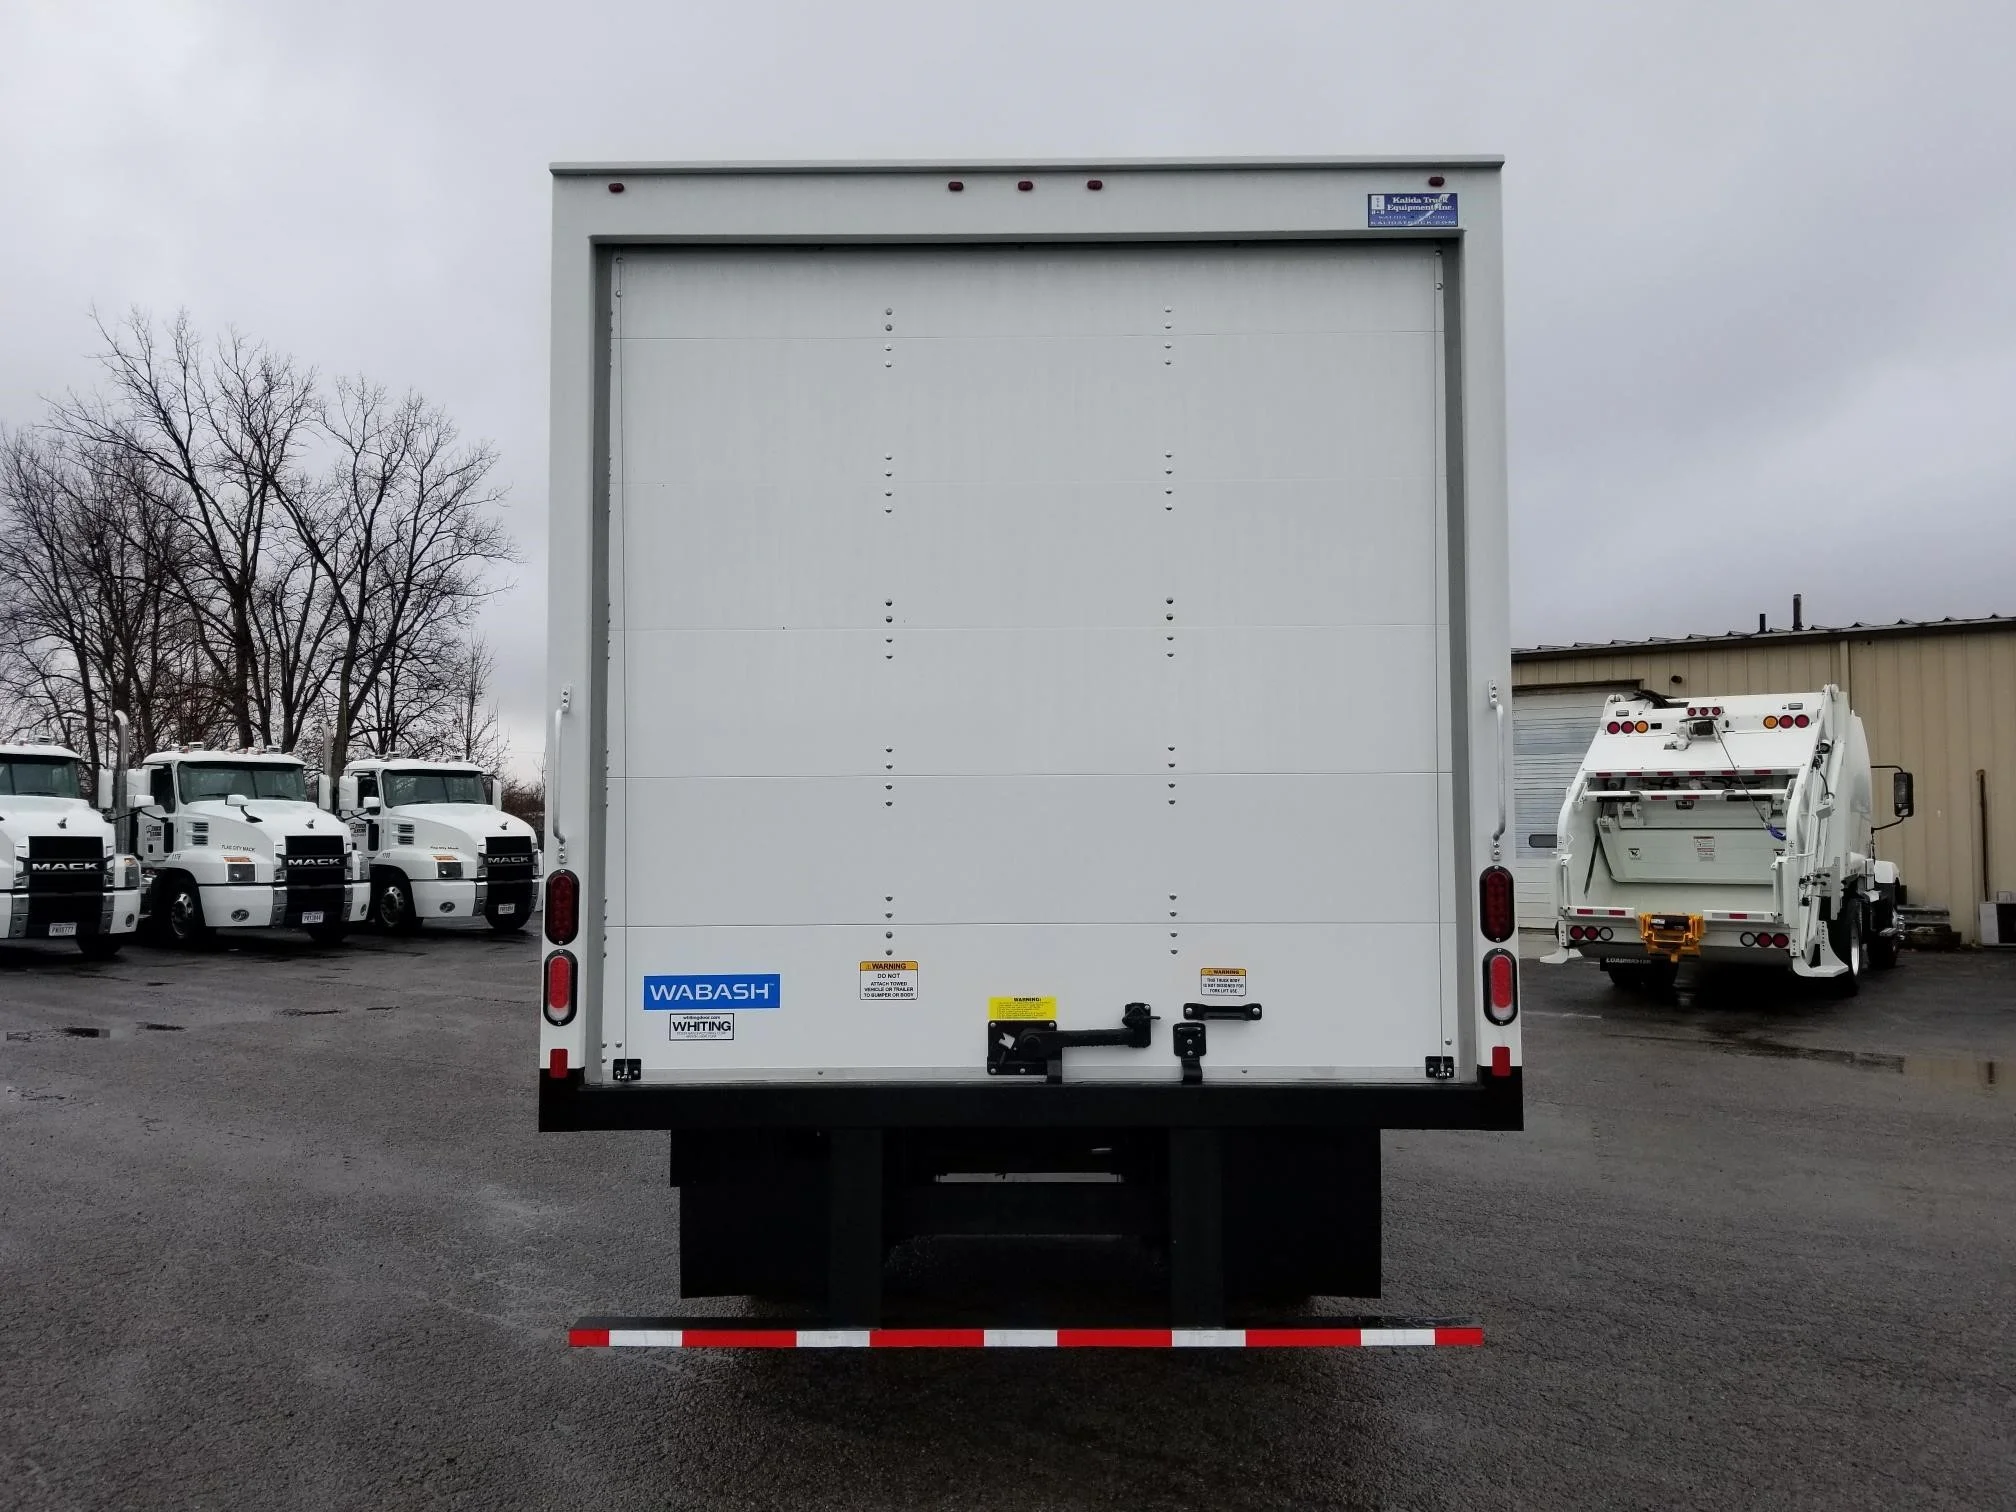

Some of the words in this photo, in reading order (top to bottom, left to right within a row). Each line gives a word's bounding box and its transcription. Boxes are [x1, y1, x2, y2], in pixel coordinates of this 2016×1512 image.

[1392, 196, 1422, 204] Kalida
[1423, 196, 1448, 204] Truck
[32, 863, 98, 871] MACK
[650, 983, 769, 1001] WABASH
[672, 1021, 732, 1032] WHITING
